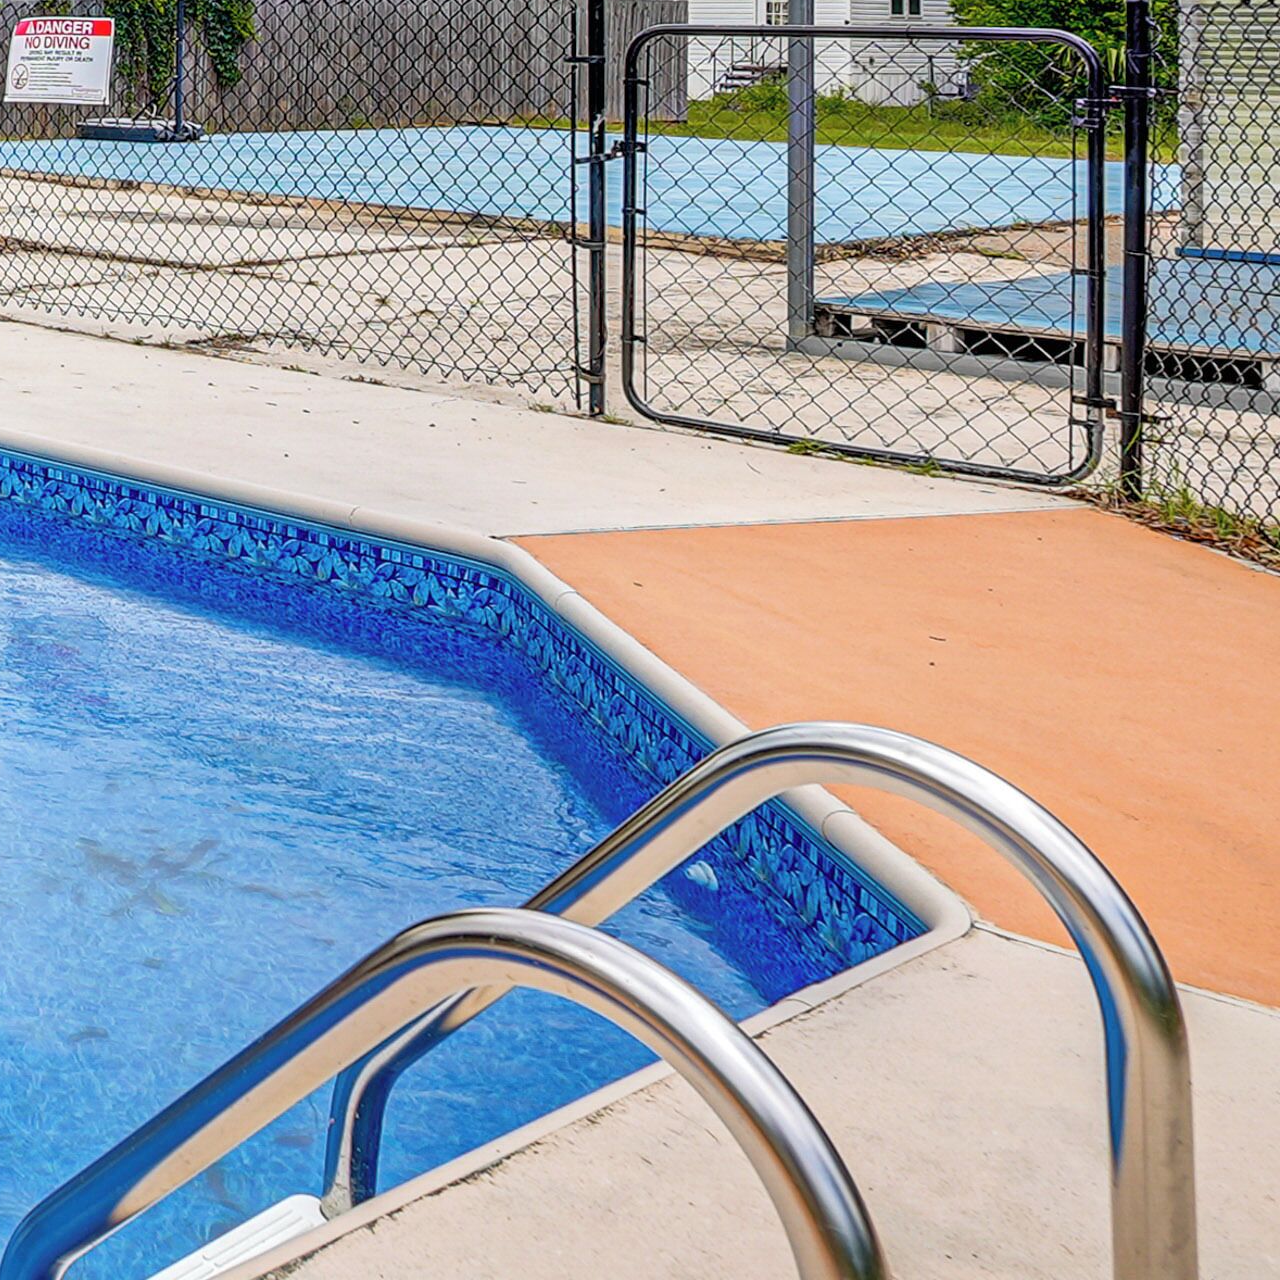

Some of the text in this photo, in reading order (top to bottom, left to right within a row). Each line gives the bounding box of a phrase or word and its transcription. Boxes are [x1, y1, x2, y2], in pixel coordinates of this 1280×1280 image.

[36, 21, 94, 34] DANGER
[25, 36, 91, 50] NO DIVING
